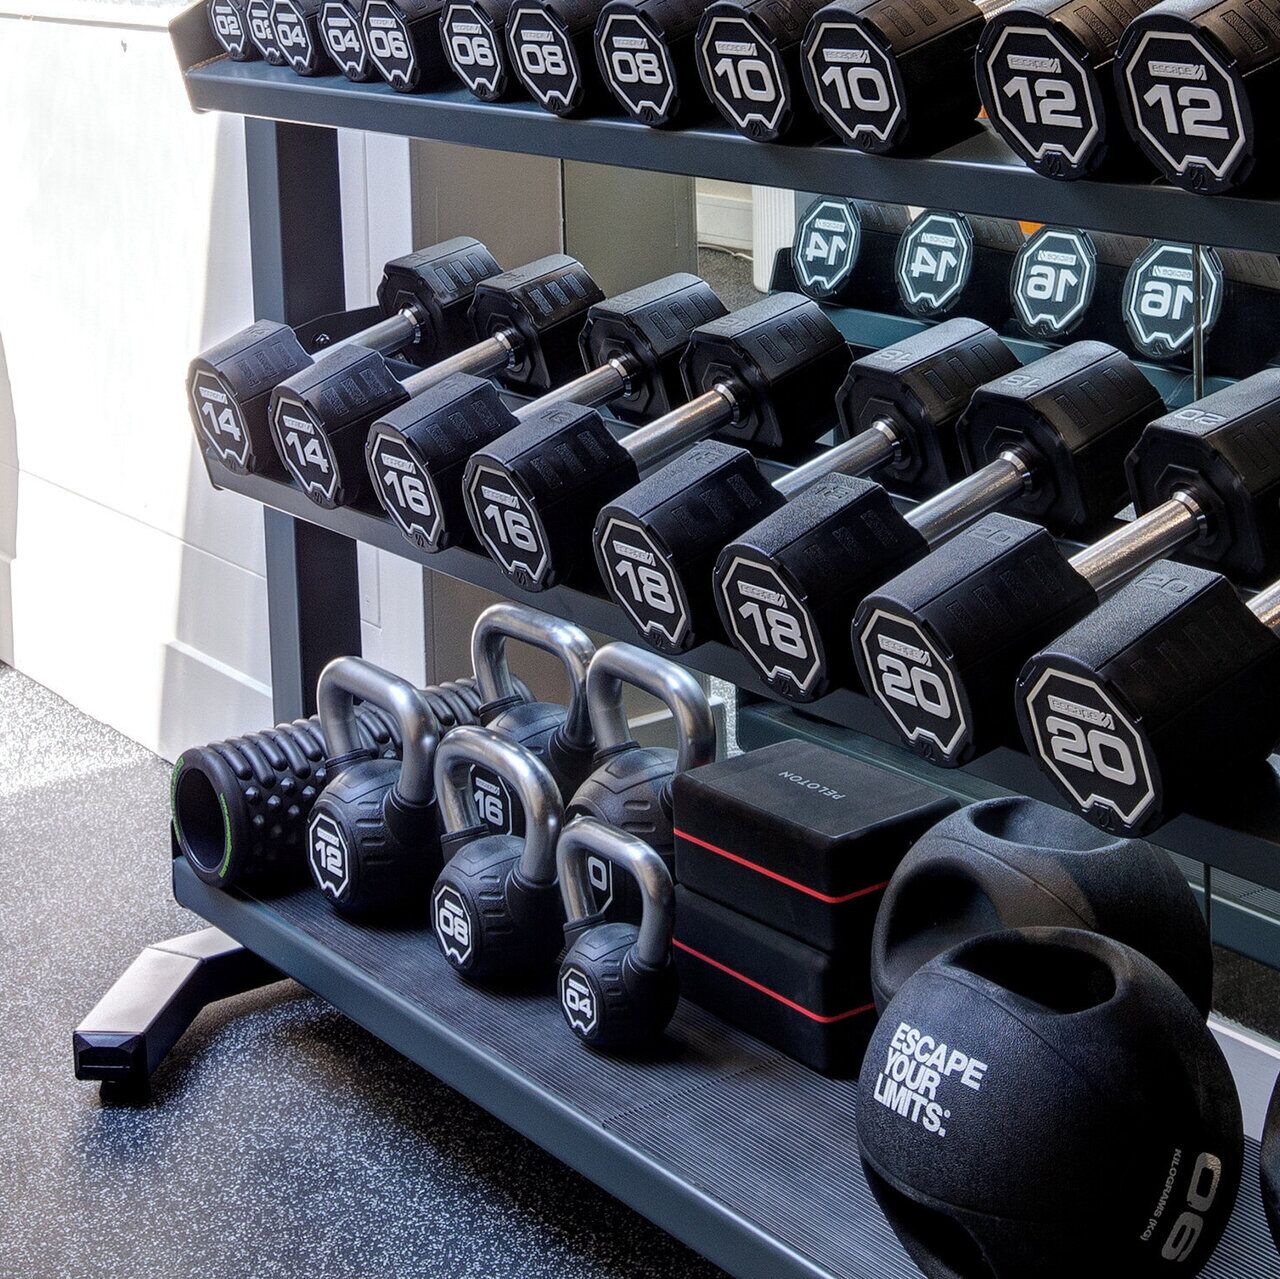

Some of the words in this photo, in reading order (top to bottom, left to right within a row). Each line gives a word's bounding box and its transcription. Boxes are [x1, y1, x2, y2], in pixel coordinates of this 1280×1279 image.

[216, 15, 241, 36] 02
[277, 24, 306, 48] 04
[329, 29, 360, 53] 04
[370, 30, 409, 59] 06
[451, 36, 495, 67] 06
[520, 44, 567, 75] 08
[611, 51, 663, 84] 08
[1009, 57, 1049, 71] escape
[1151, 63, 1192, 78] escape
[714, 58, 776, 103] 10
[821, 66, 890, 112] 10
[1002, 76, 1083, 128] 12
[1143, 83, 1230, 140] 12
[202, 401, 241, 442] 14
[285, 431, 328, 473] 14
[384, 470, 431, 517] 16
[484, 505, 536, 553] 16
[615, 560, 675, 614] 18
[738, 601, 807, 659] 18
[877, 653, 951, 719] 20
[1045, 716, 1137, 786] 20
[778, 770, 846, 801] PELOTON
[474, 791, 504, 826] 16
[315, 840, 343, 878] 12
[438, 908, 469, 946] 08
[565, 987, 593, 1019] 04
[884, 1046, 940, 1101] YOUR
[890, 1021, 988, 1091] ESCAPE
[1153, 1148, 1182, 1218] KILOGRAMS
[1161, 1151, 1222, 1262] 06
[1140, 1218, 1158, 1241] (KG)
